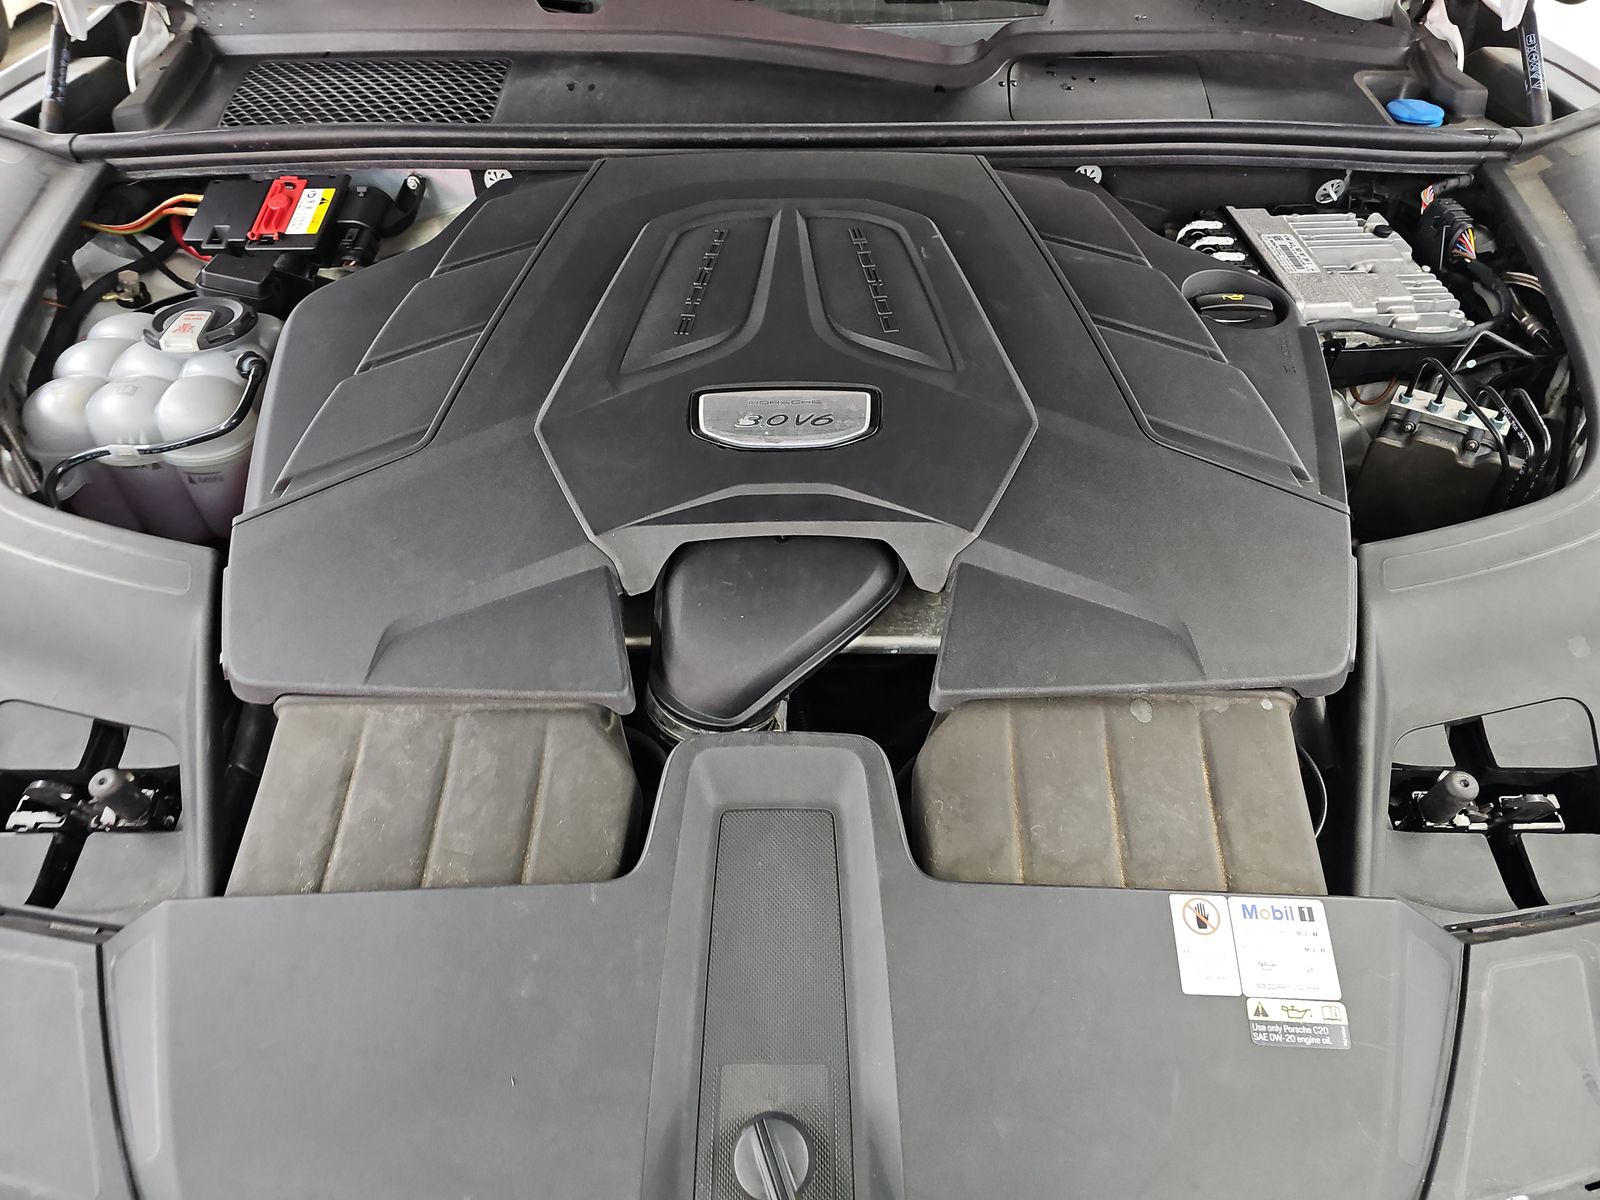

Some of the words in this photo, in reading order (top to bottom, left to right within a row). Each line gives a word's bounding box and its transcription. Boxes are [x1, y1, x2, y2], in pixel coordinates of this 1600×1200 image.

[848, 228, 900, 333] PORSCHE
[1241, 903, 1294, 921] Mobil
[1252, 1023, 1266, 1032] Use
[1267, 1024, 1282, 1034] only
[1283, 1025, 1312, 1034] Porsche
[1312, 1026, 1329, 1035] C20
[1253, 1032, 1269, 1042] SAE
[1296, 1036, 1320, 1046] engine
